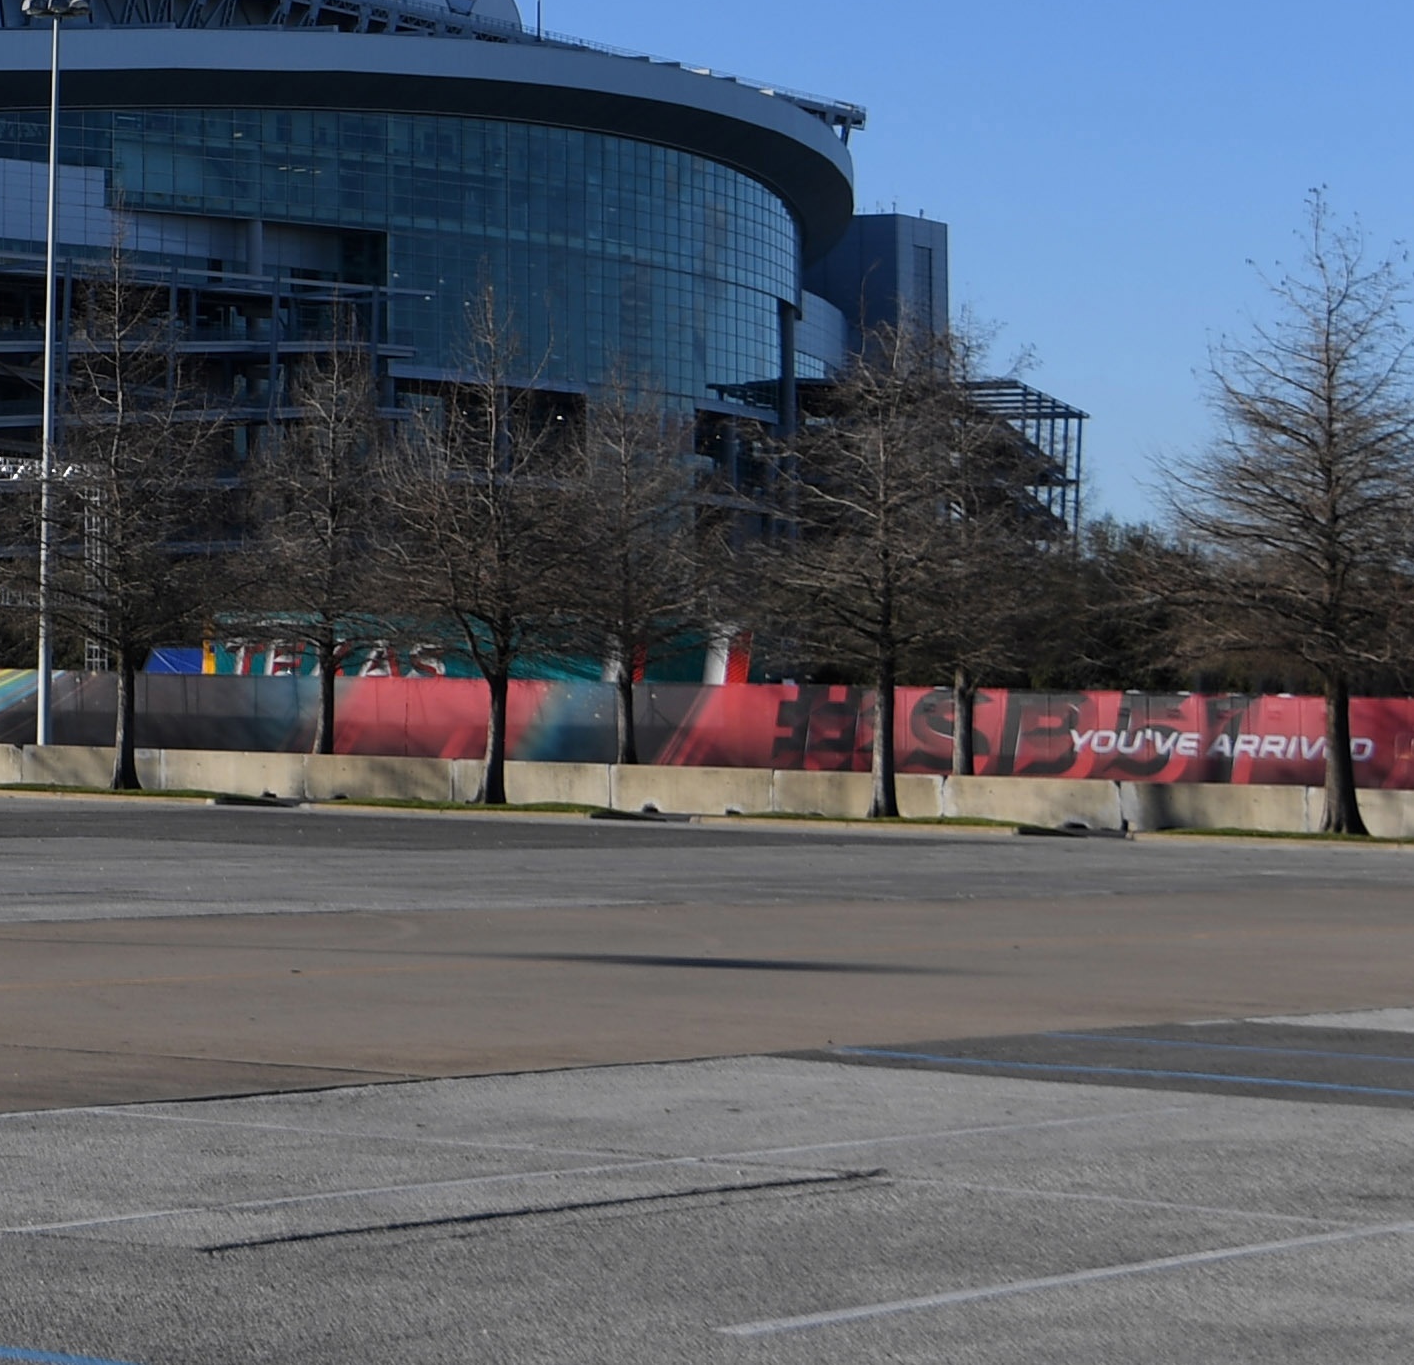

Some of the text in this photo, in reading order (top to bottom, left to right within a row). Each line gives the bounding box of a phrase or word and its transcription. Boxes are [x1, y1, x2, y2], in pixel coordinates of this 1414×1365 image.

[226, 638, 446, 676] TEXAS
[1071, 729, 1374, 762] YOU'VE ARRIVD
